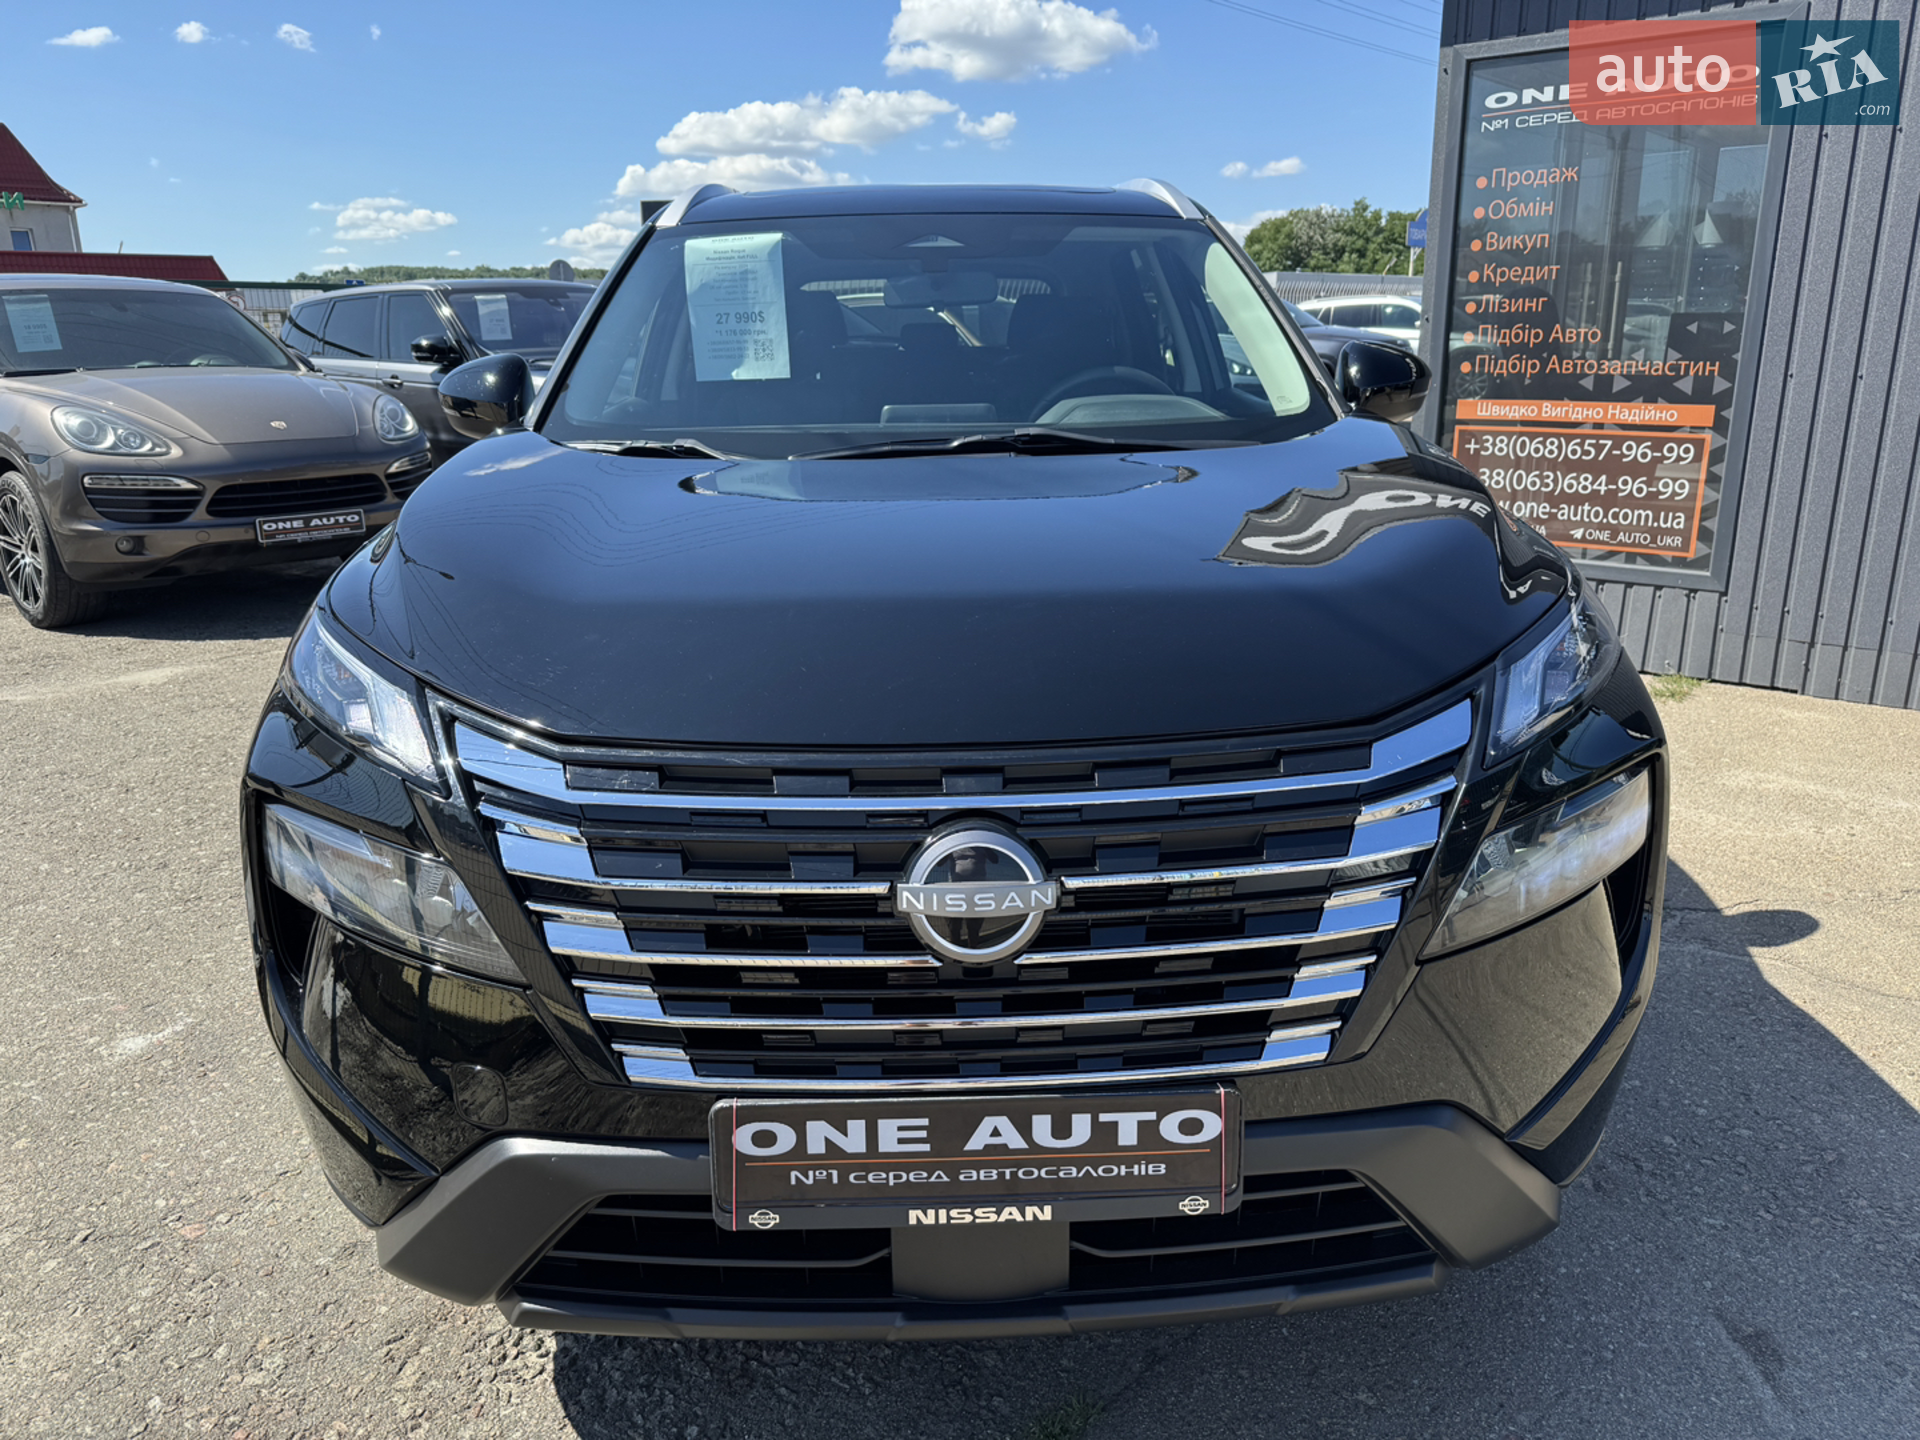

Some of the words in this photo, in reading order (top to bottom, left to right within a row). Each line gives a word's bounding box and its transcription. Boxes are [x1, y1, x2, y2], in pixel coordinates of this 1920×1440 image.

[1484, 82, 1588, 109] ONE
[1605, 64, 1760, 96] AUTO
[1515, 110, 1588, 128] СЕРЕД
[1491, 166, 1579, 192] Продаж
[1488, 197, 1554, 220] Обмін
[1485, 231, 1550, 255] Викуп
[1482, 263, 1561, 288] Кредит
[1478, 294, 1548, 314] Лізинг
[716, 312, 730, 325] 27
[734, 310, 765, 324] 990$
[1477, 323, 1544, 349] Підбір
[1549, 323, 1602, 344] Авто
[1474, 354, 1541, 377] Підбір
[1546, 354, 1720, 377] Автозапчастин
[1476, 402, 1538, 419] Швидко
[1541, 404, 1604, 420] Вигідно
[1607, 405, 1678, 422] Надійно
[1464, 435, 1696, 465] +38(068)657-96-99
[1479, 468, 1690, 501] 38(063)684-96-99
[263, 519, 305, 531] ONE
[310, 514, 360, 527] AUTO
[1585, 529, 1682, 548] ONE_AUTO_UKR
[902, 887, 1053, 912] NISSAN
[732, 1117, 932, 1157] ONE
[962, 1109, 1223, 1151] AUTO
[789, 1169, 839, 1186] №1
[848, 1170, 951, 1187] серед
[958, 1160, 1167, 1182] автосалонів
[907, 1204, 1053, 1225] NISSAN
[1180, 1200, 1208, 1209] NISSAN
[750, 1214, 778, 1223] NISSAN
